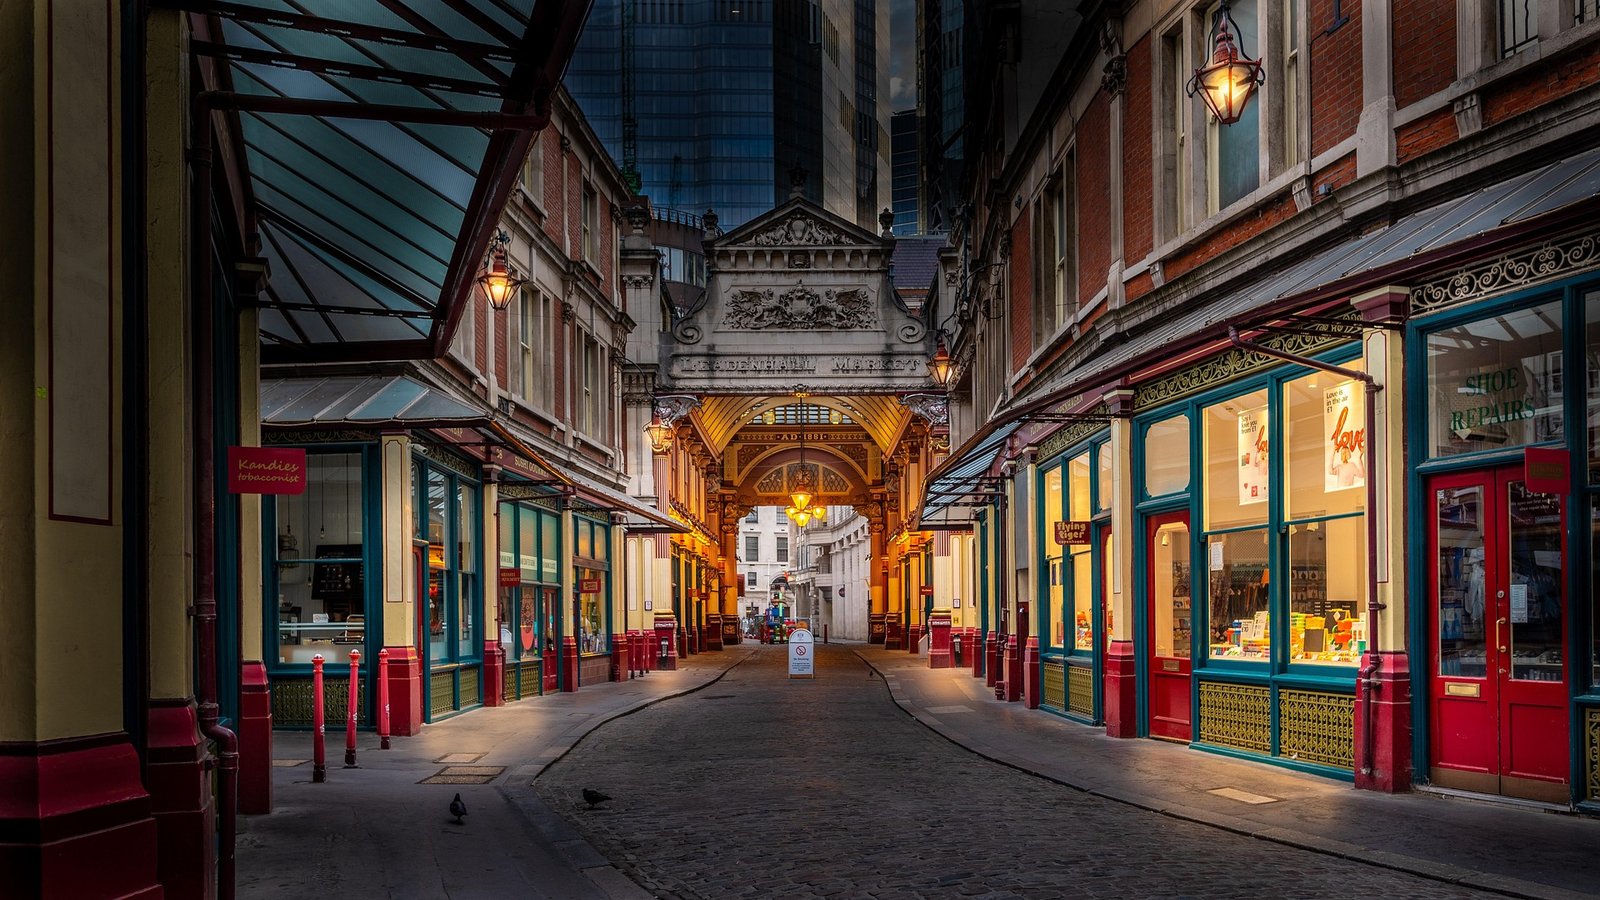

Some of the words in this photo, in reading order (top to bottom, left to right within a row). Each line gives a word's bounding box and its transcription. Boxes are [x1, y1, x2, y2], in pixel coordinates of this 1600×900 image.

[680, 357, 815, 371] LEADENHALL
[832, 357, 921, 370] MARKET
[1465, 367, 1519, 397] SHOE
[1326, 390, 1338, 399] Love
[1451, 397, 1536, 432] REPAIRS
[238, 459, 299, 472] Kandies
[238, 472, 300, 483] tobacconist
[1057, 522, 1086, 532] flying
[1059, 530, 1084, 540] tiger
[953, 616, 959, 624] H
